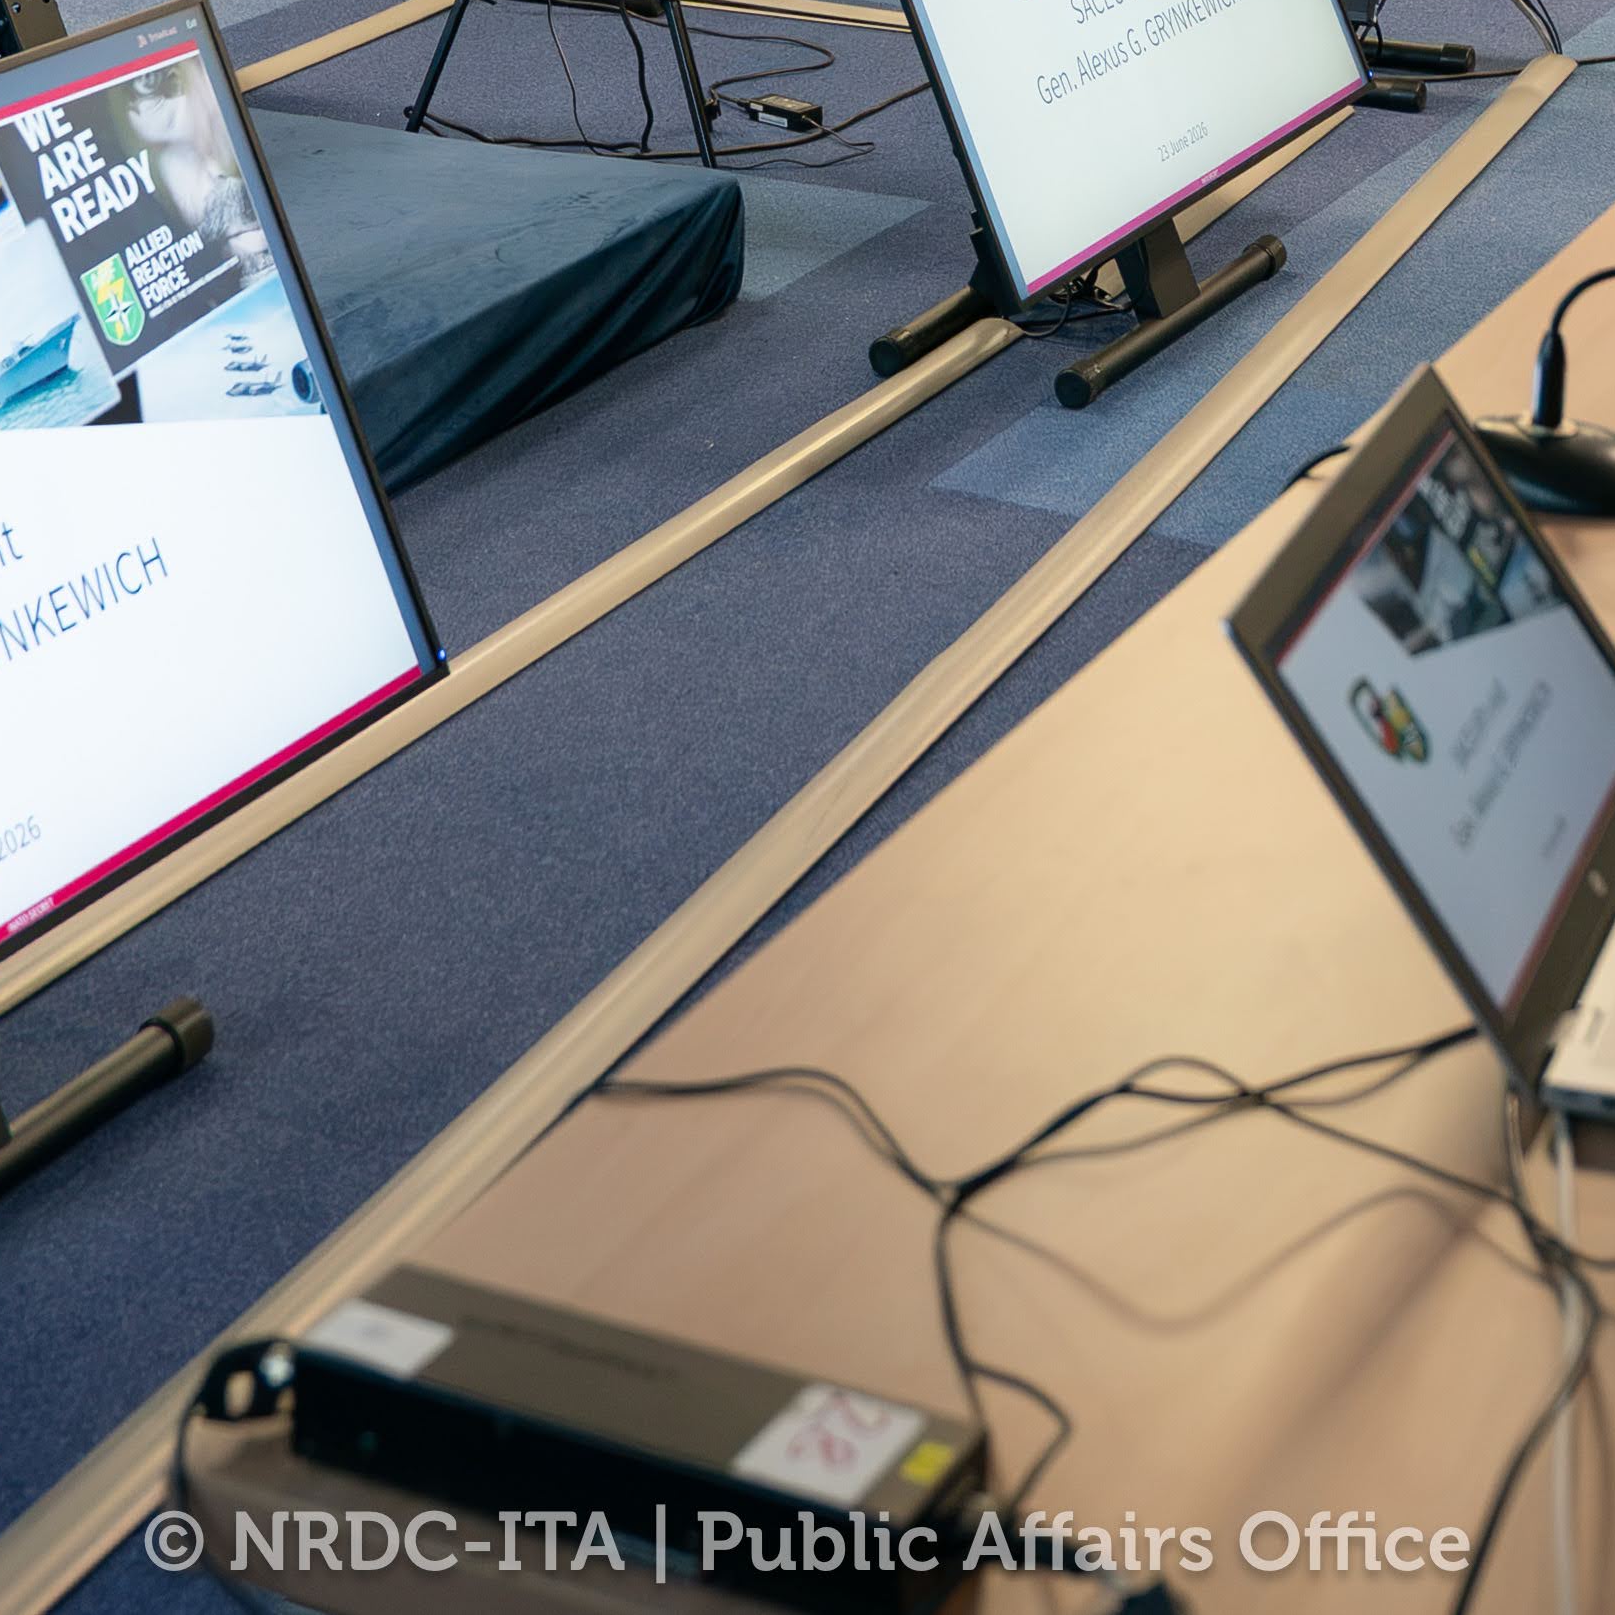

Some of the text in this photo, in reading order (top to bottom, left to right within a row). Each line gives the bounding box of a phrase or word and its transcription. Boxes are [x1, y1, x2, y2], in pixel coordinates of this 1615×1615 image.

[1037, 72, 1078, 105] Gen.
[1076, 42, 1129, 86] Alexus
[1127, 28, 1147, 56] G.
[13, 105, 74, 153] WE
[1157, 121, 1208, 162] 23 June 2026
[38, 128, 106, 200] ARE
[51, 149, 156, 243] READY
[125, 225, 173, 269] ALLIED
[131, 231, 204, 289] REACTION
[139, 265, 190, 309] FORCE
